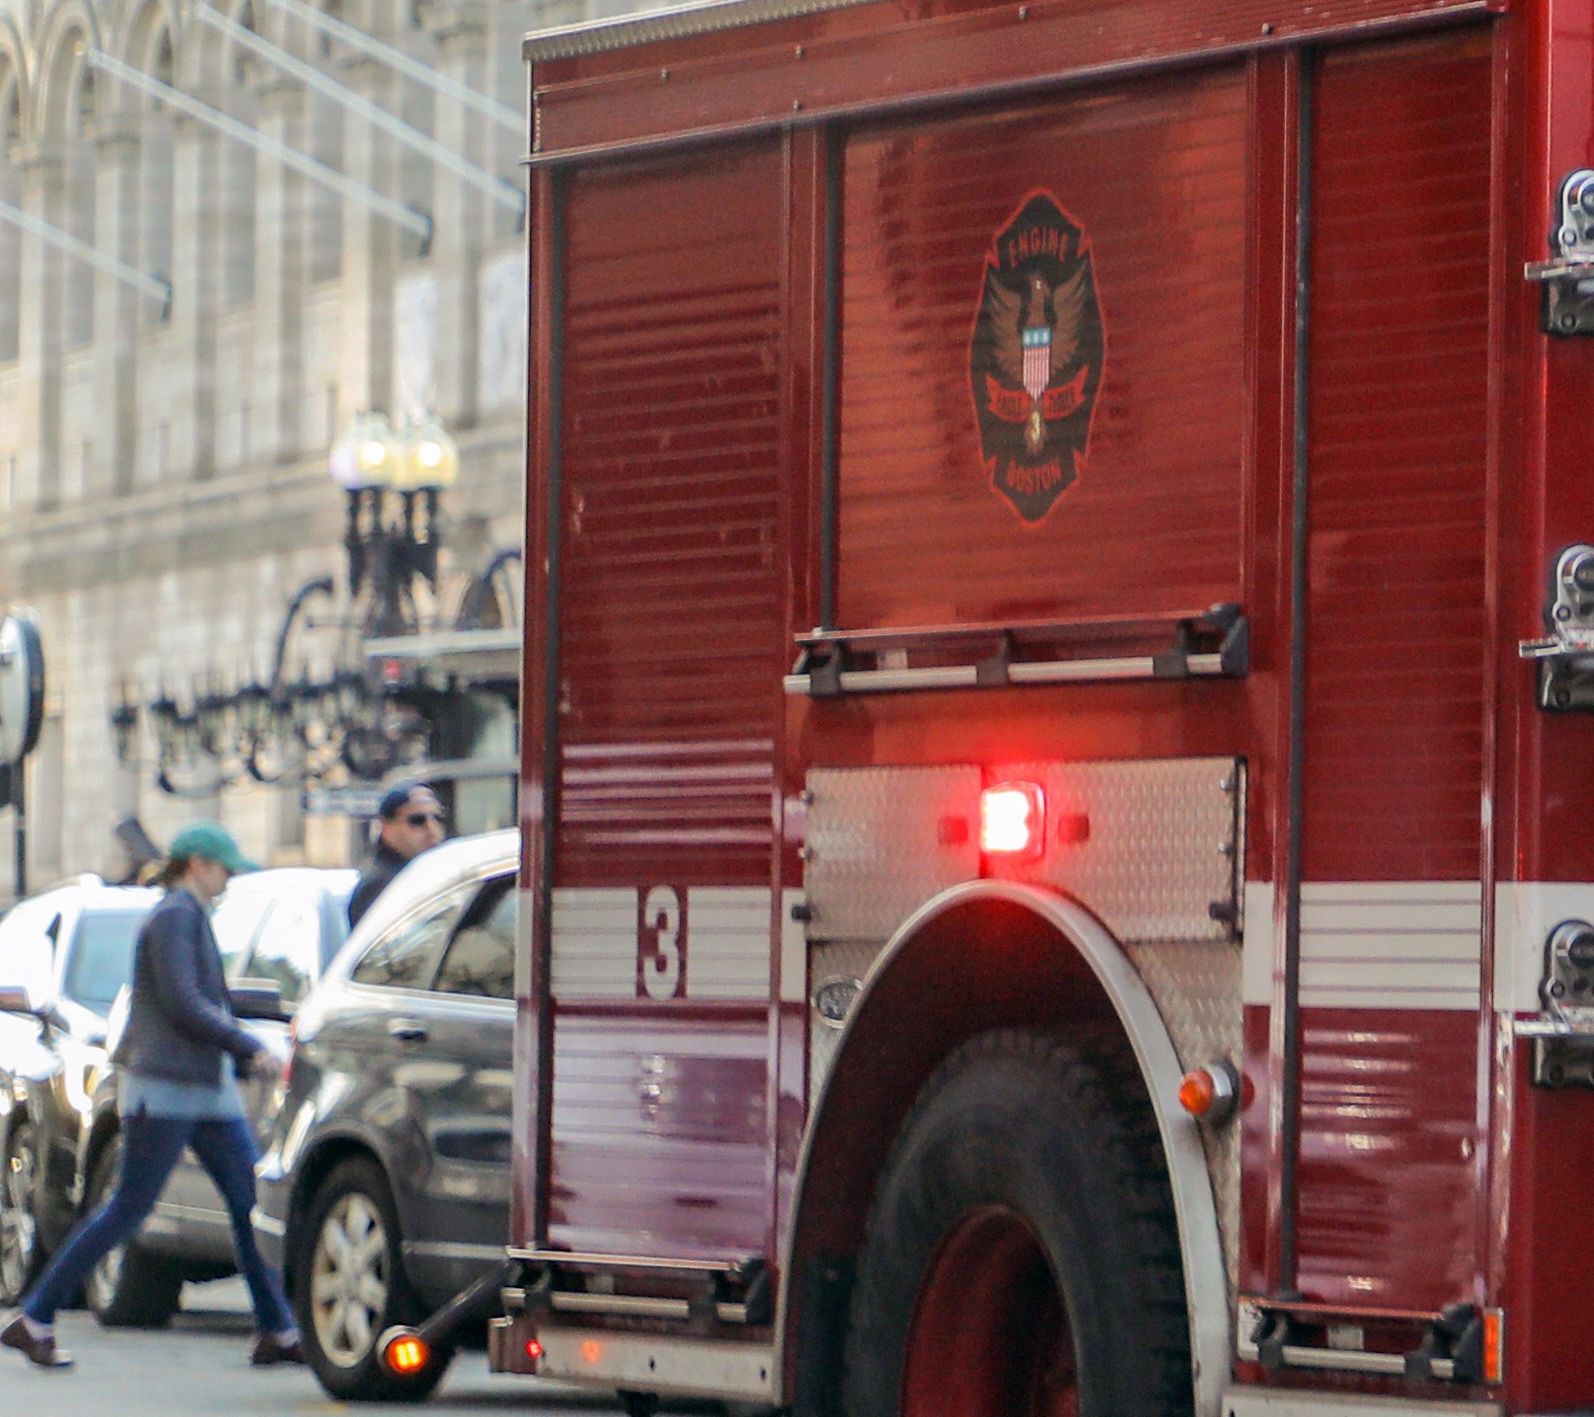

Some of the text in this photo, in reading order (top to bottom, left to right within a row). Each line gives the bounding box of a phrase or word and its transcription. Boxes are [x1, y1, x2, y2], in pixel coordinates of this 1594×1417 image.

[1008, 226, 1070, 269] ENGINE
[1005, 457, 1062, 494] BOSTON
[643, 884, 682, 1001] 3
